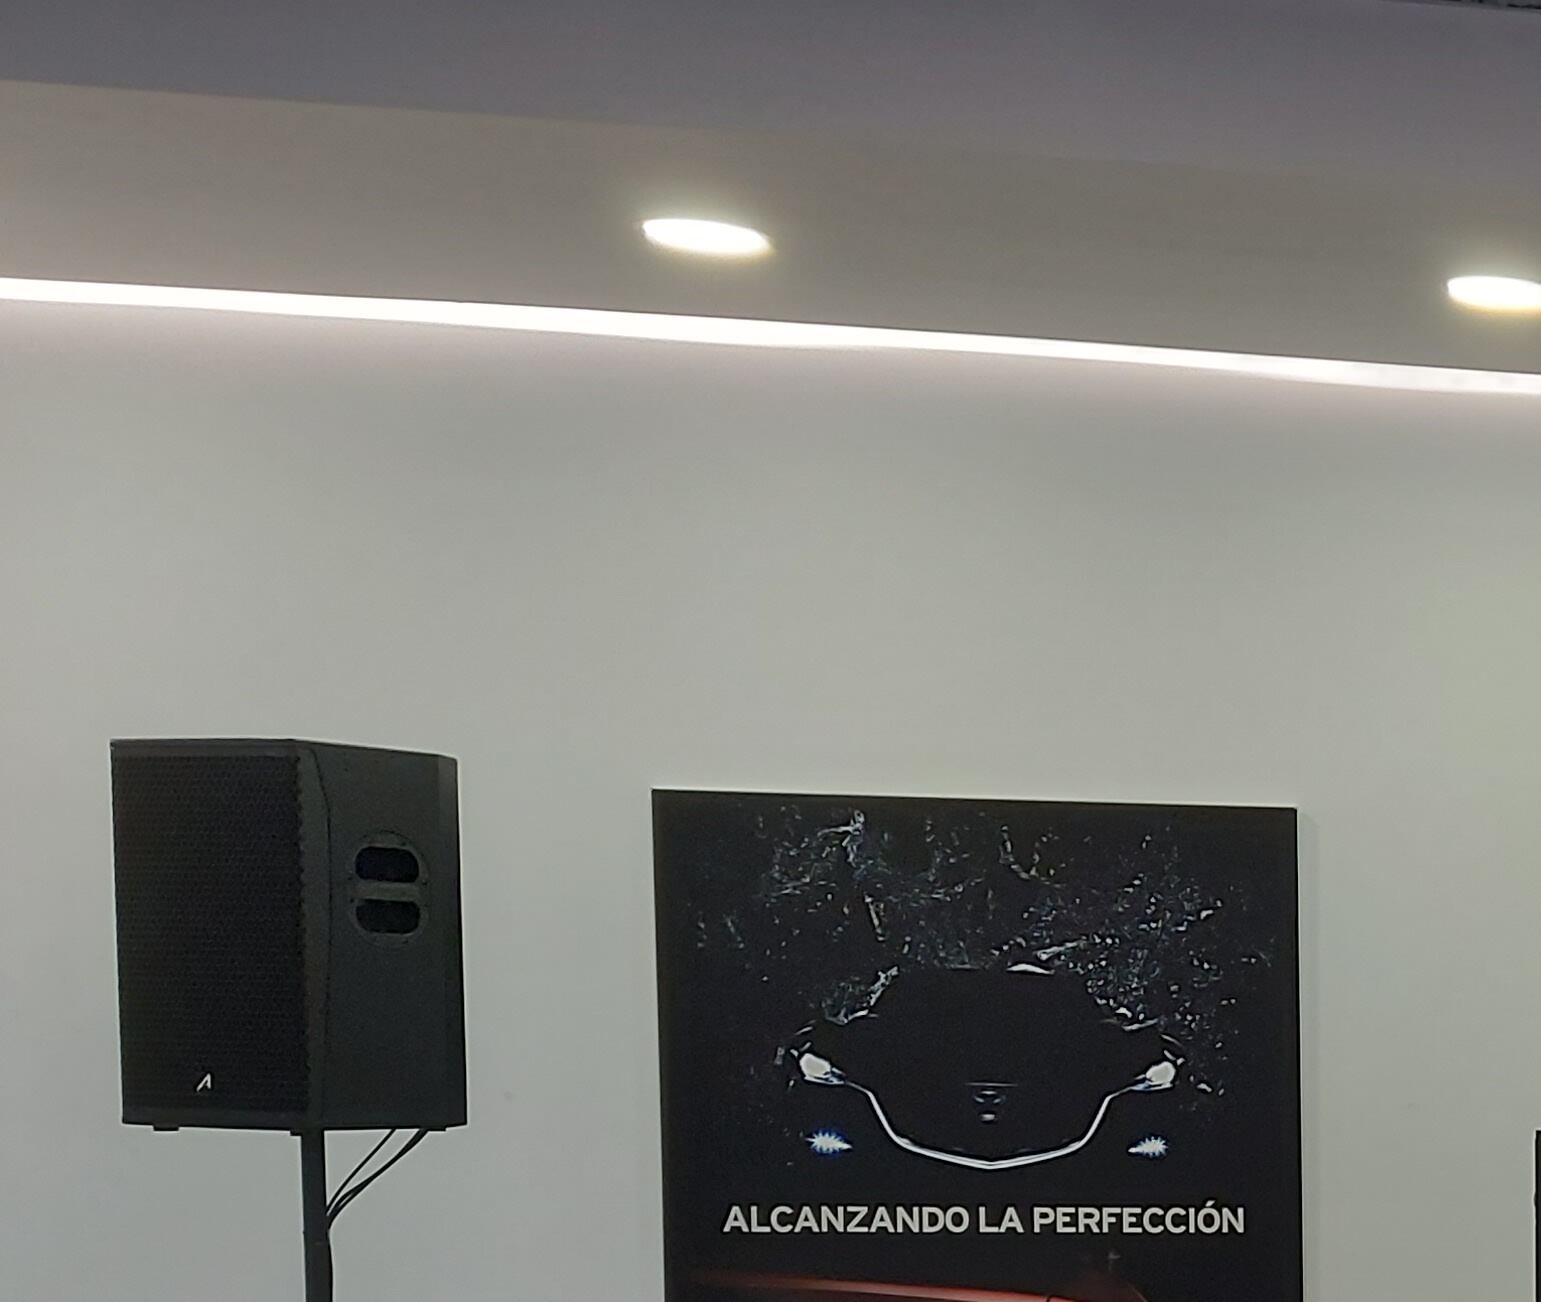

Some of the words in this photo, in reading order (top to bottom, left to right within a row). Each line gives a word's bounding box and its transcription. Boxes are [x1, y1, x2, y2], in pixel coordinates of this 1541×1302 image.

[722, 1205, 970, 1234] ALCANZANDO
[978, 1205, 1025, 1234] LA
[1032, 1199, 1246, 1234] PERFECCIÓN
